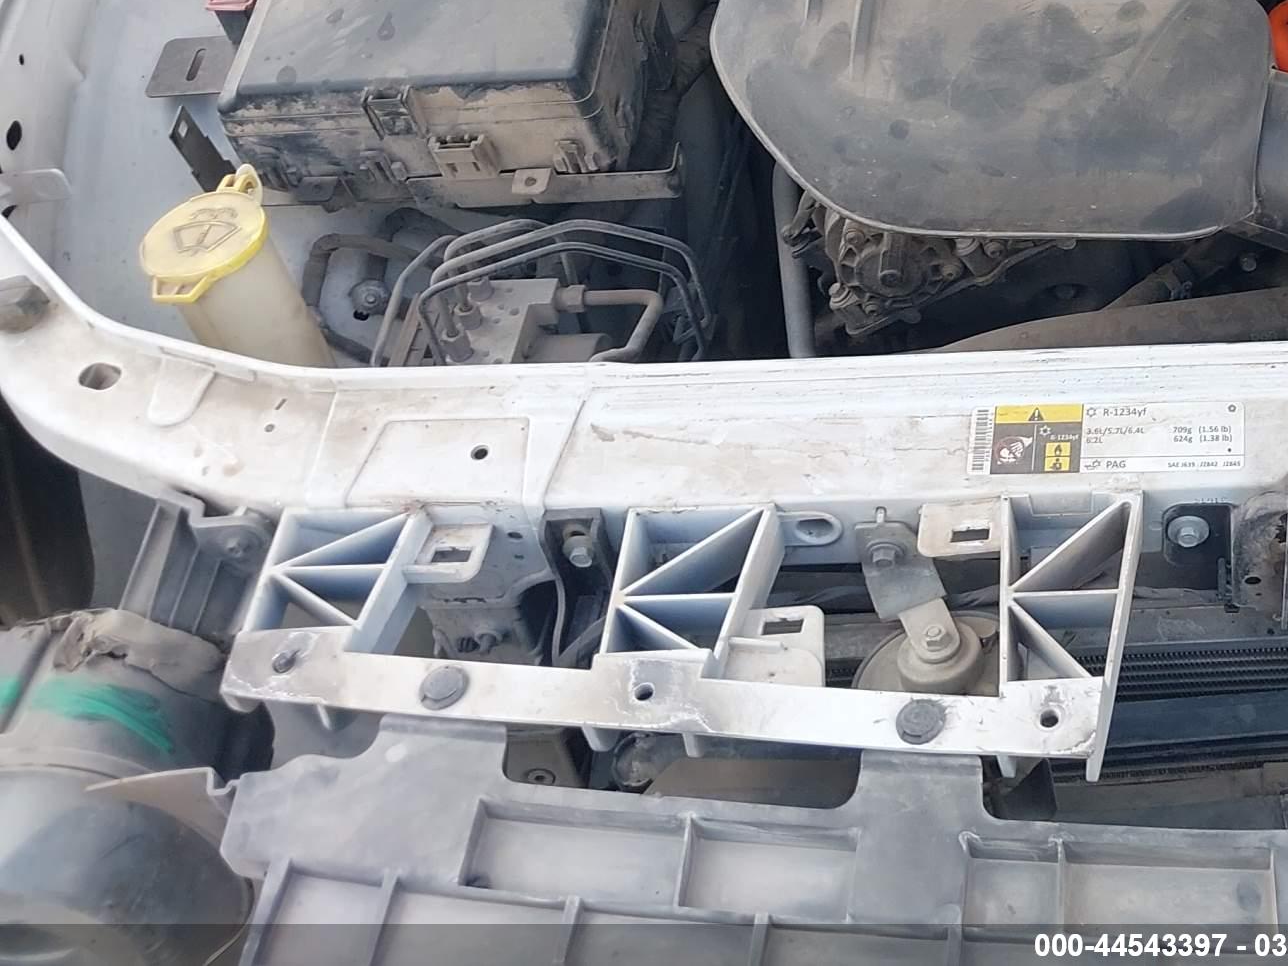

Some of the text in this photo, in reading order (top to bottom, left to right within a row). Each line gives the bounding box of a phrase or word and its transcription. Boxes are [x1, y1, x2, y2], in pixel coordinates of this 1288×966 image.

[1103, 407, 1147, 418] R-1234yf
[1172, 426, 1192, 434] 709g
[1198, 425, 1219, 433] (1.56
[1173, 435, 1193, 444] 624g
[1106, 460, 1127, 469] PAG
